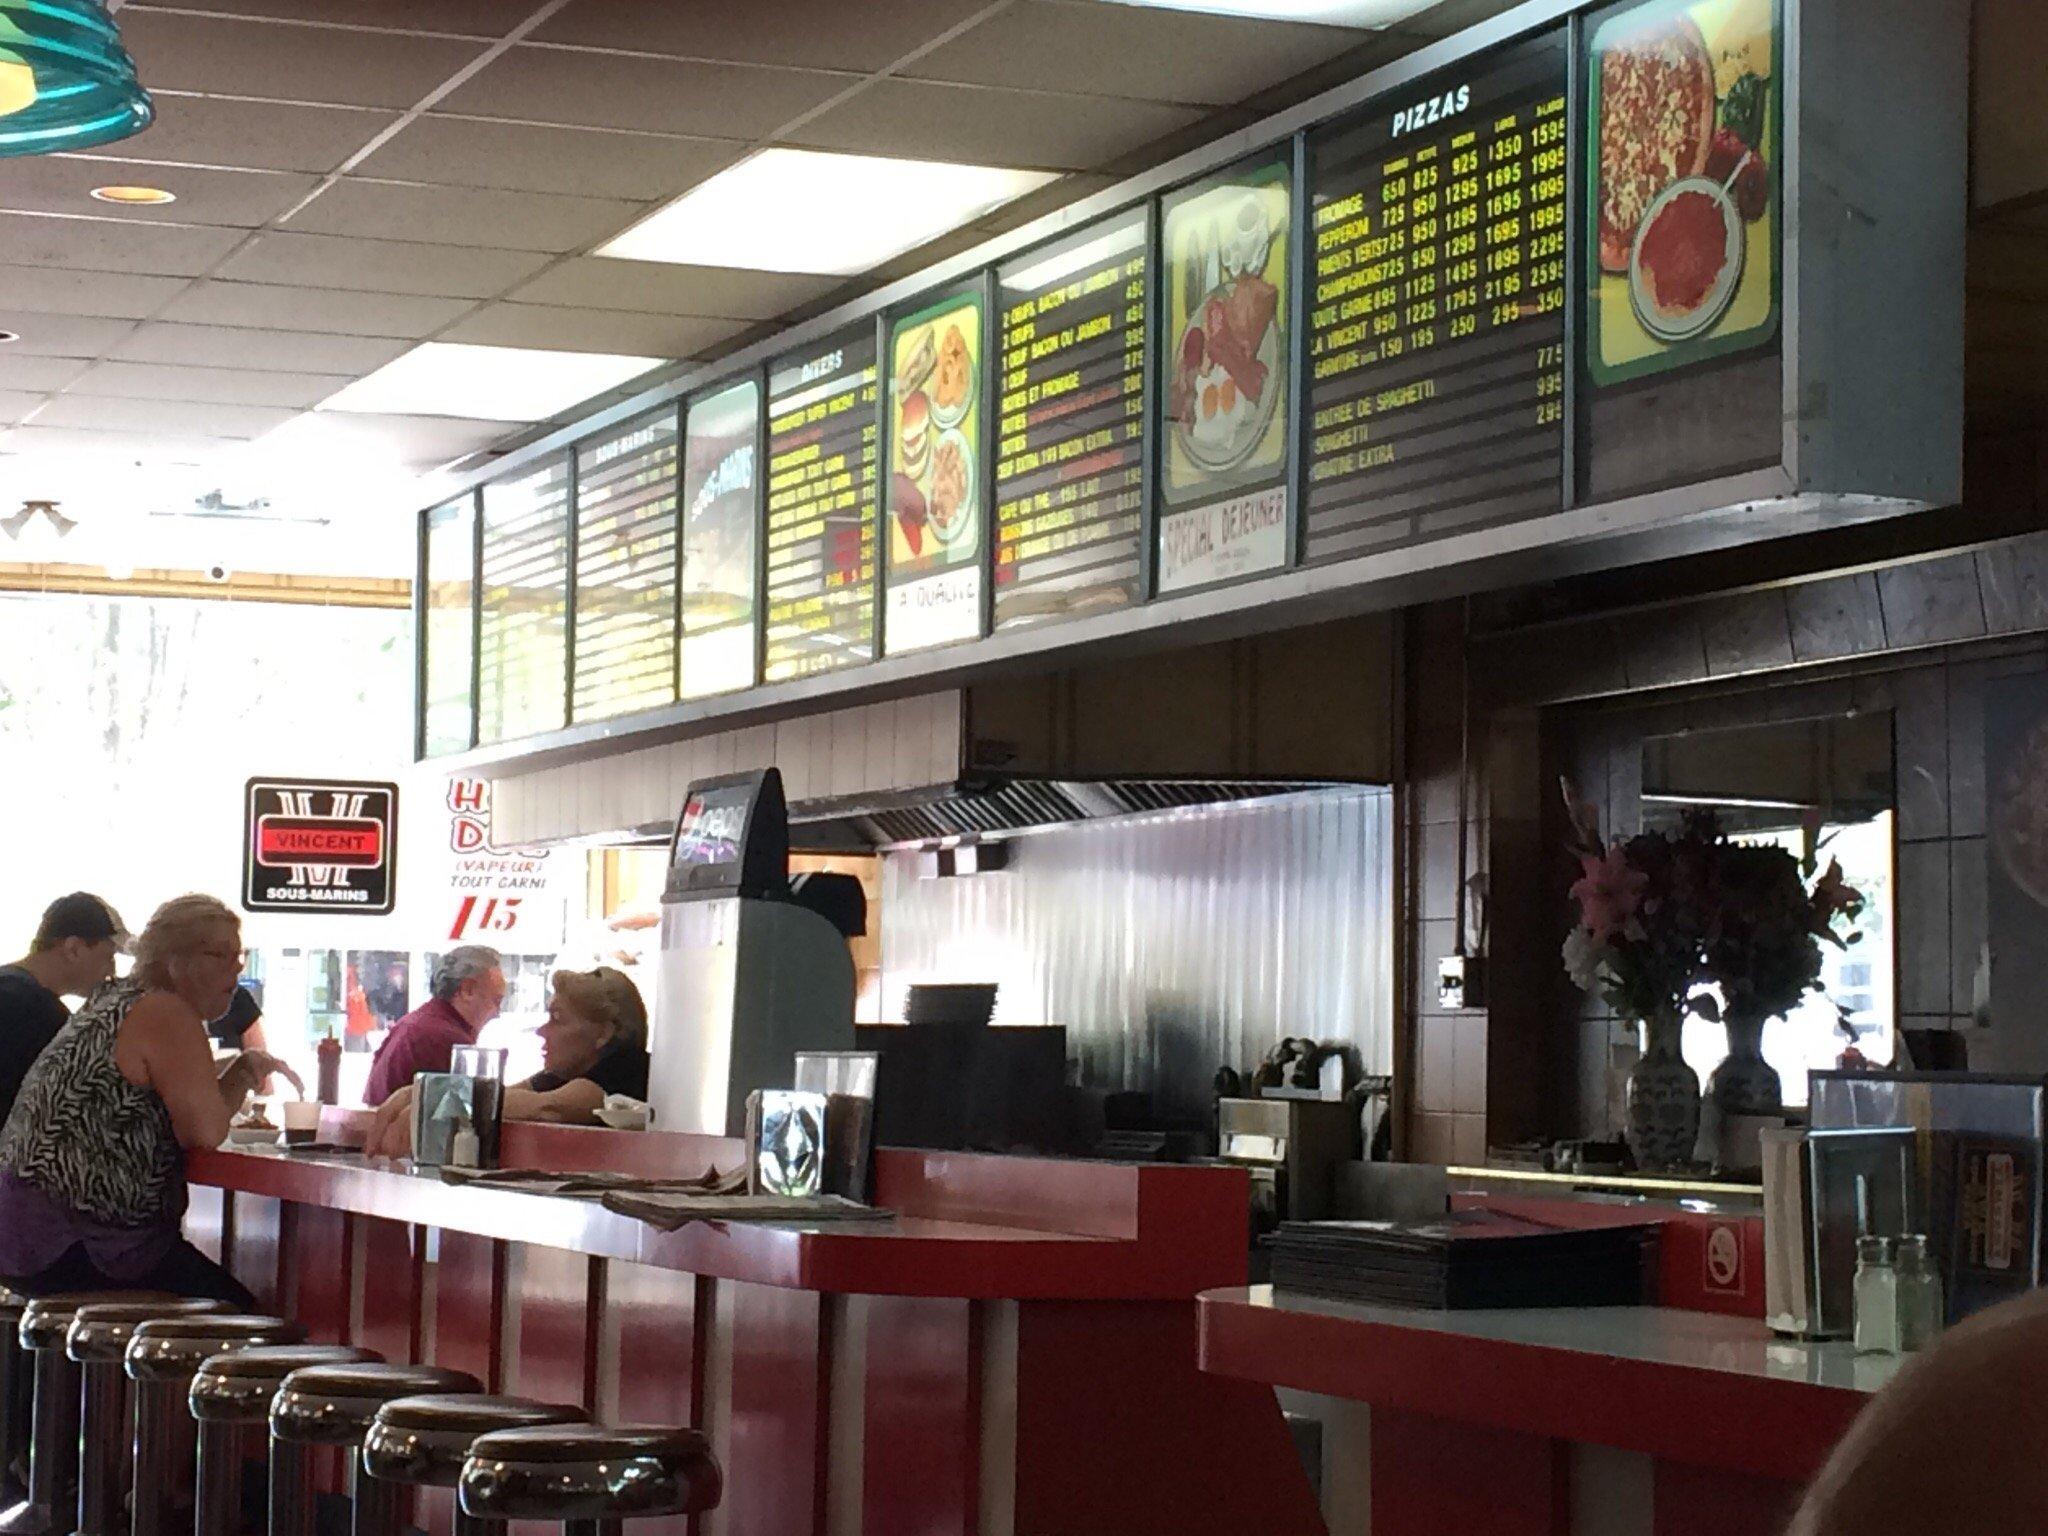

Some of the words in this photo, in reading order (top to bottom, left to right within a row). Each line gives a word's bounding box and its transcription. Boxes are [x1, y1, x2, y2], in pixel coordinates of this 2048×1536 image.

[1392, 84, 1470, 137] PIZZAS
[1413, 166, 1438, 191] 825
[1489, 134, 1521, 160] 1350
[1318, 217, 1369, 251] PEPPERONI
[1383, 203, 1405, 228] 725
[1446, 177, 1478, 205] 1295
[1486, 163, 1521, 190] 1695
[1531, 146, 1564, 174] 1995
[1381, 231, 1404, 259] 725
[1413, 219, 1437, 244] 950
[1446, 204, 1478, 231] 1295
[1486, 190, 1521, 217] 1695
[1530, 174, 1564, 203] 1995
[1317, 267, 1382, 303] CHAMPIGNONS
[1381, 257, 1404, 284] 725
[1445, 231, 1477, 258] 1295
[1486, 217, 1520, 245] 1695
[1530, 203, 1564, 231] 1995
[1405, 274, 1436, 300] 1125
[1446, 262, 1477, 286] 1495
[1327, 322, 1367, 348] VINCENT
[1406, 299, 1436, 325] 1225
[1485, 273, 1520, 300] 2195
[1450, 315, 1476, 338] 250
[1492, 301, 1519, 326] 295
[1537, 287, 1563, 314] 350
[275, 831, 366, 850] VINCENT
[456, 860, 542, 873] (VAPEUR)
[267, 887, 368, 901] SOUS-MARINS
[451, 876, 493, 888] TOUT
[498, 877, 546, 889] GARNI
